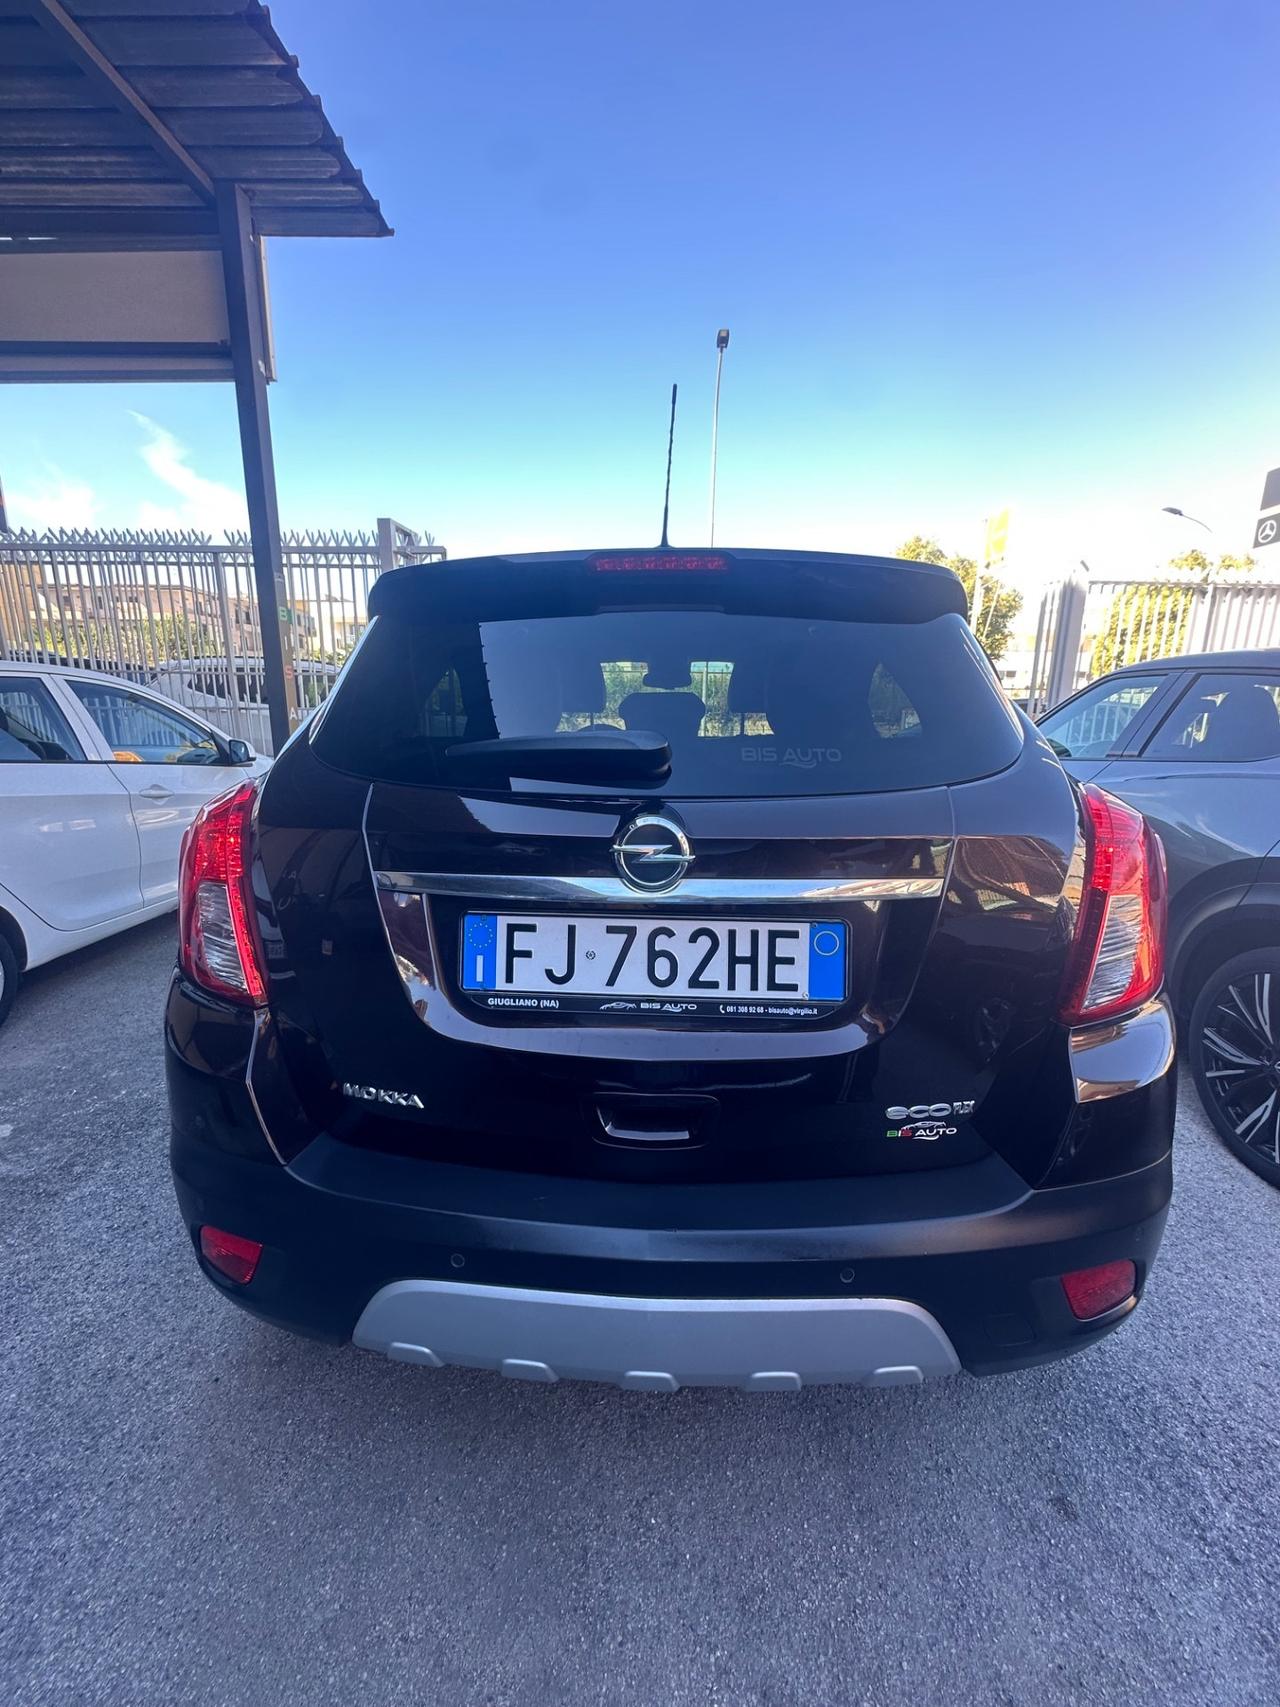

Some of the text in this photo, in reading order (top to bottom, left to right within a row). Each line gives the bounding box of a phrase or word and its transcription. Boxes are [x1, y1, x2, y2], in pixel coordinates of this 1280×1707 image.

[741, 747, 842, 763] BIS AUTO
[487, 998, 559, 1009] GIUGLIANO (NA)
[661, 1003, 697, 1011] AUTO
[343, 1083, 424, 1108] MOKKA
[886, 1127, 957, 1137] BIS AUTO
